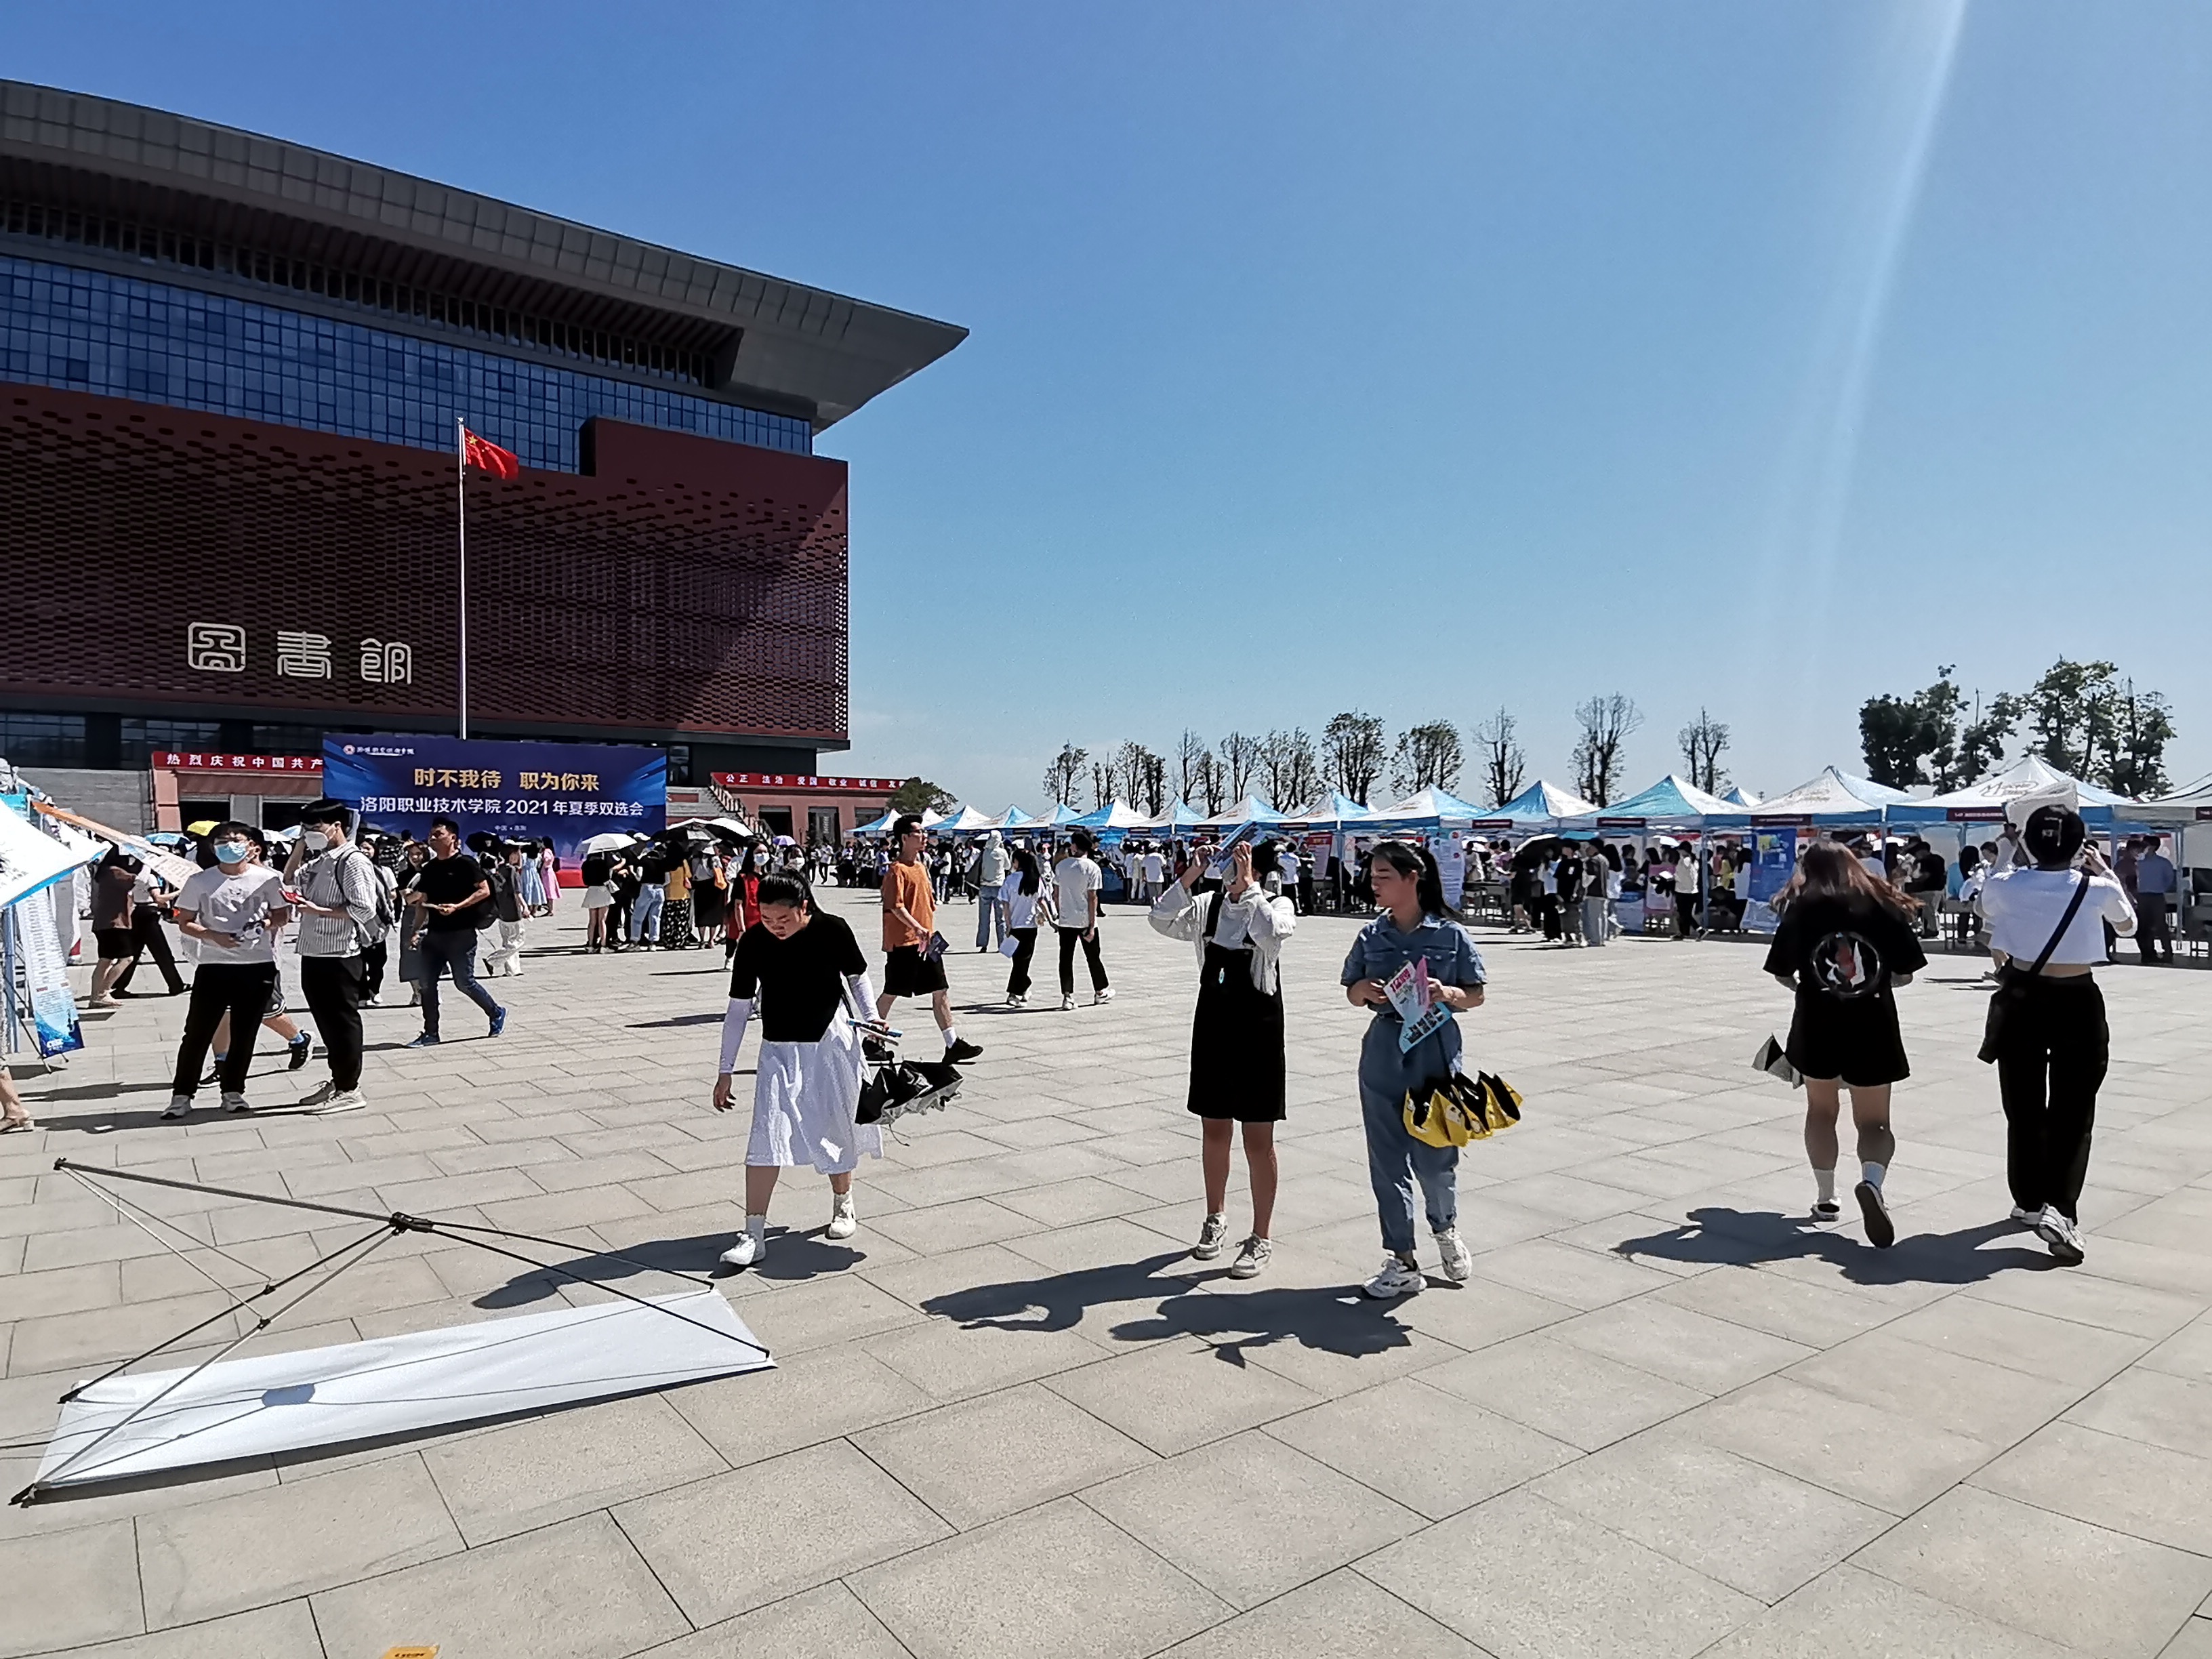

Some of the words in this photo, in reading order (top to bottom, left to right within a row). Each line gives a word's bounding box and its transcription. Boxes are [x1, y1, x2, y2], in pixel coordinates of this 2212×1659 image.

[414, 767, 502, 789] 时不我待
[519, 771, 600, 792] 职为你来
[360, 796, 501, 814] 洛阳职业技术学院
[505, 799, 548, 815] 2021
[552, 800, 644, 816] 年夏季双选会
